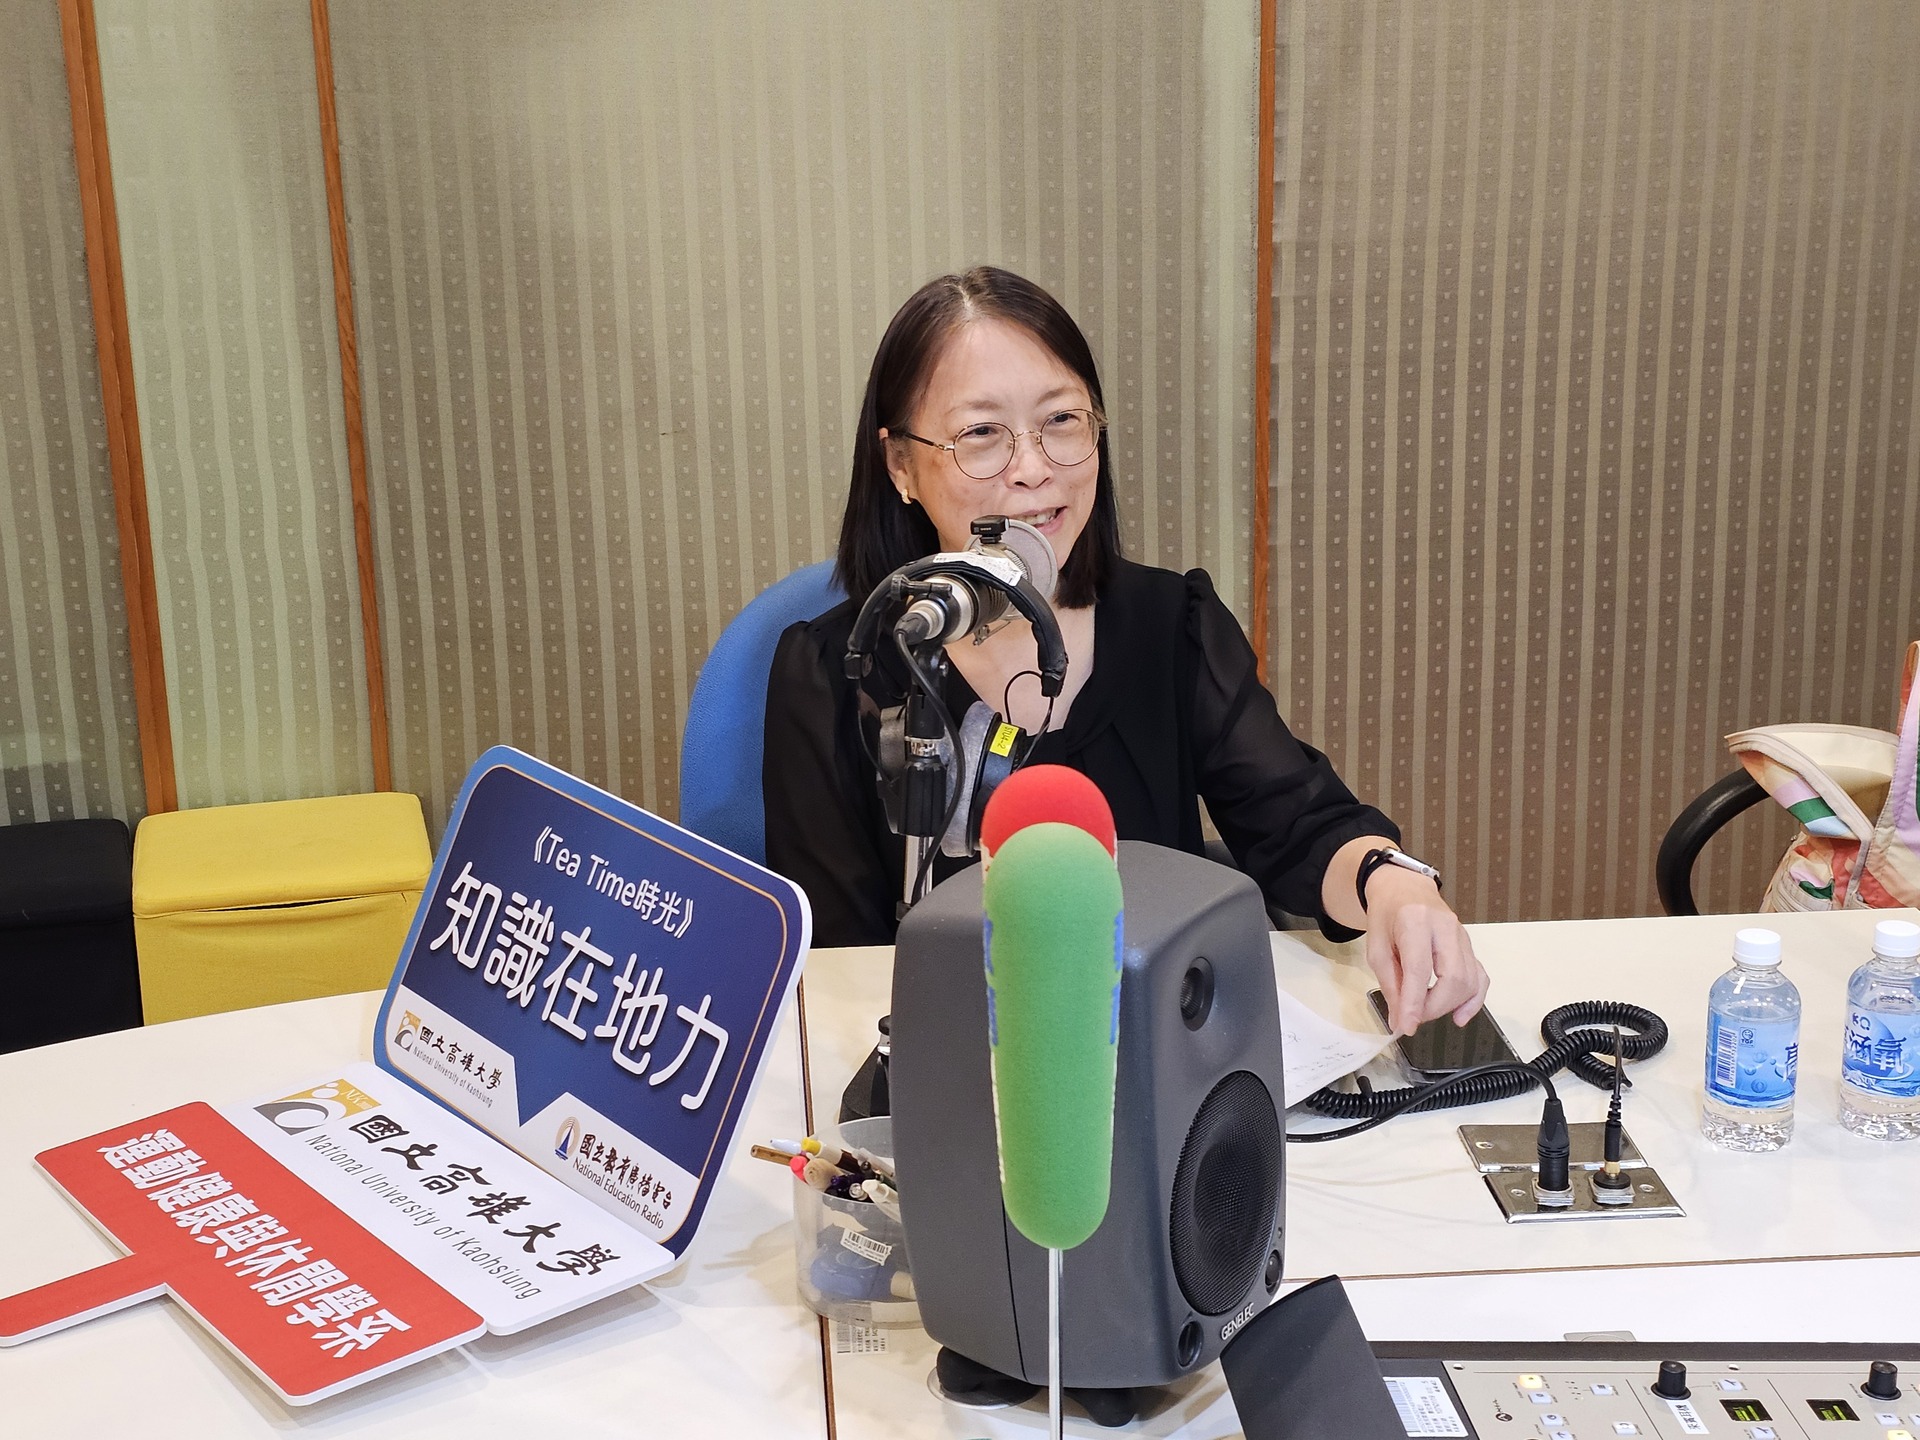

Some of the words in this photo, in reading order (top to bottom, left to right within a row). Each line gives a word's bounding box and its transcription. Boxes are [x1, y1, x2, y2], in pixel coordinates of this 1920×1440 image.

[429, 861, 730, 1110] 知識在地力
[413, 1046, 434, 1066] National
[433, 1061, 459, 1085] University
[466, 1082, 494, 1108] Kaohsiung
[419, 1026, 503, 1090] 國立高雄大學
[305, 1134, 374, 1176] National
[361, 1173, 440, 1227] University
[433, 1226, 466, 1240] of
[452, 1237, 542, 1300] Kaohsiung
[348, 1114, 621, 1276] 國立高雄大學
[573, 1156, 605, 1188] National
[603, 1178, 641, 1213] Education
[640, 1204, 664, 1229] Radio
[1221, 1302, 1255, 1340] GENELEC
